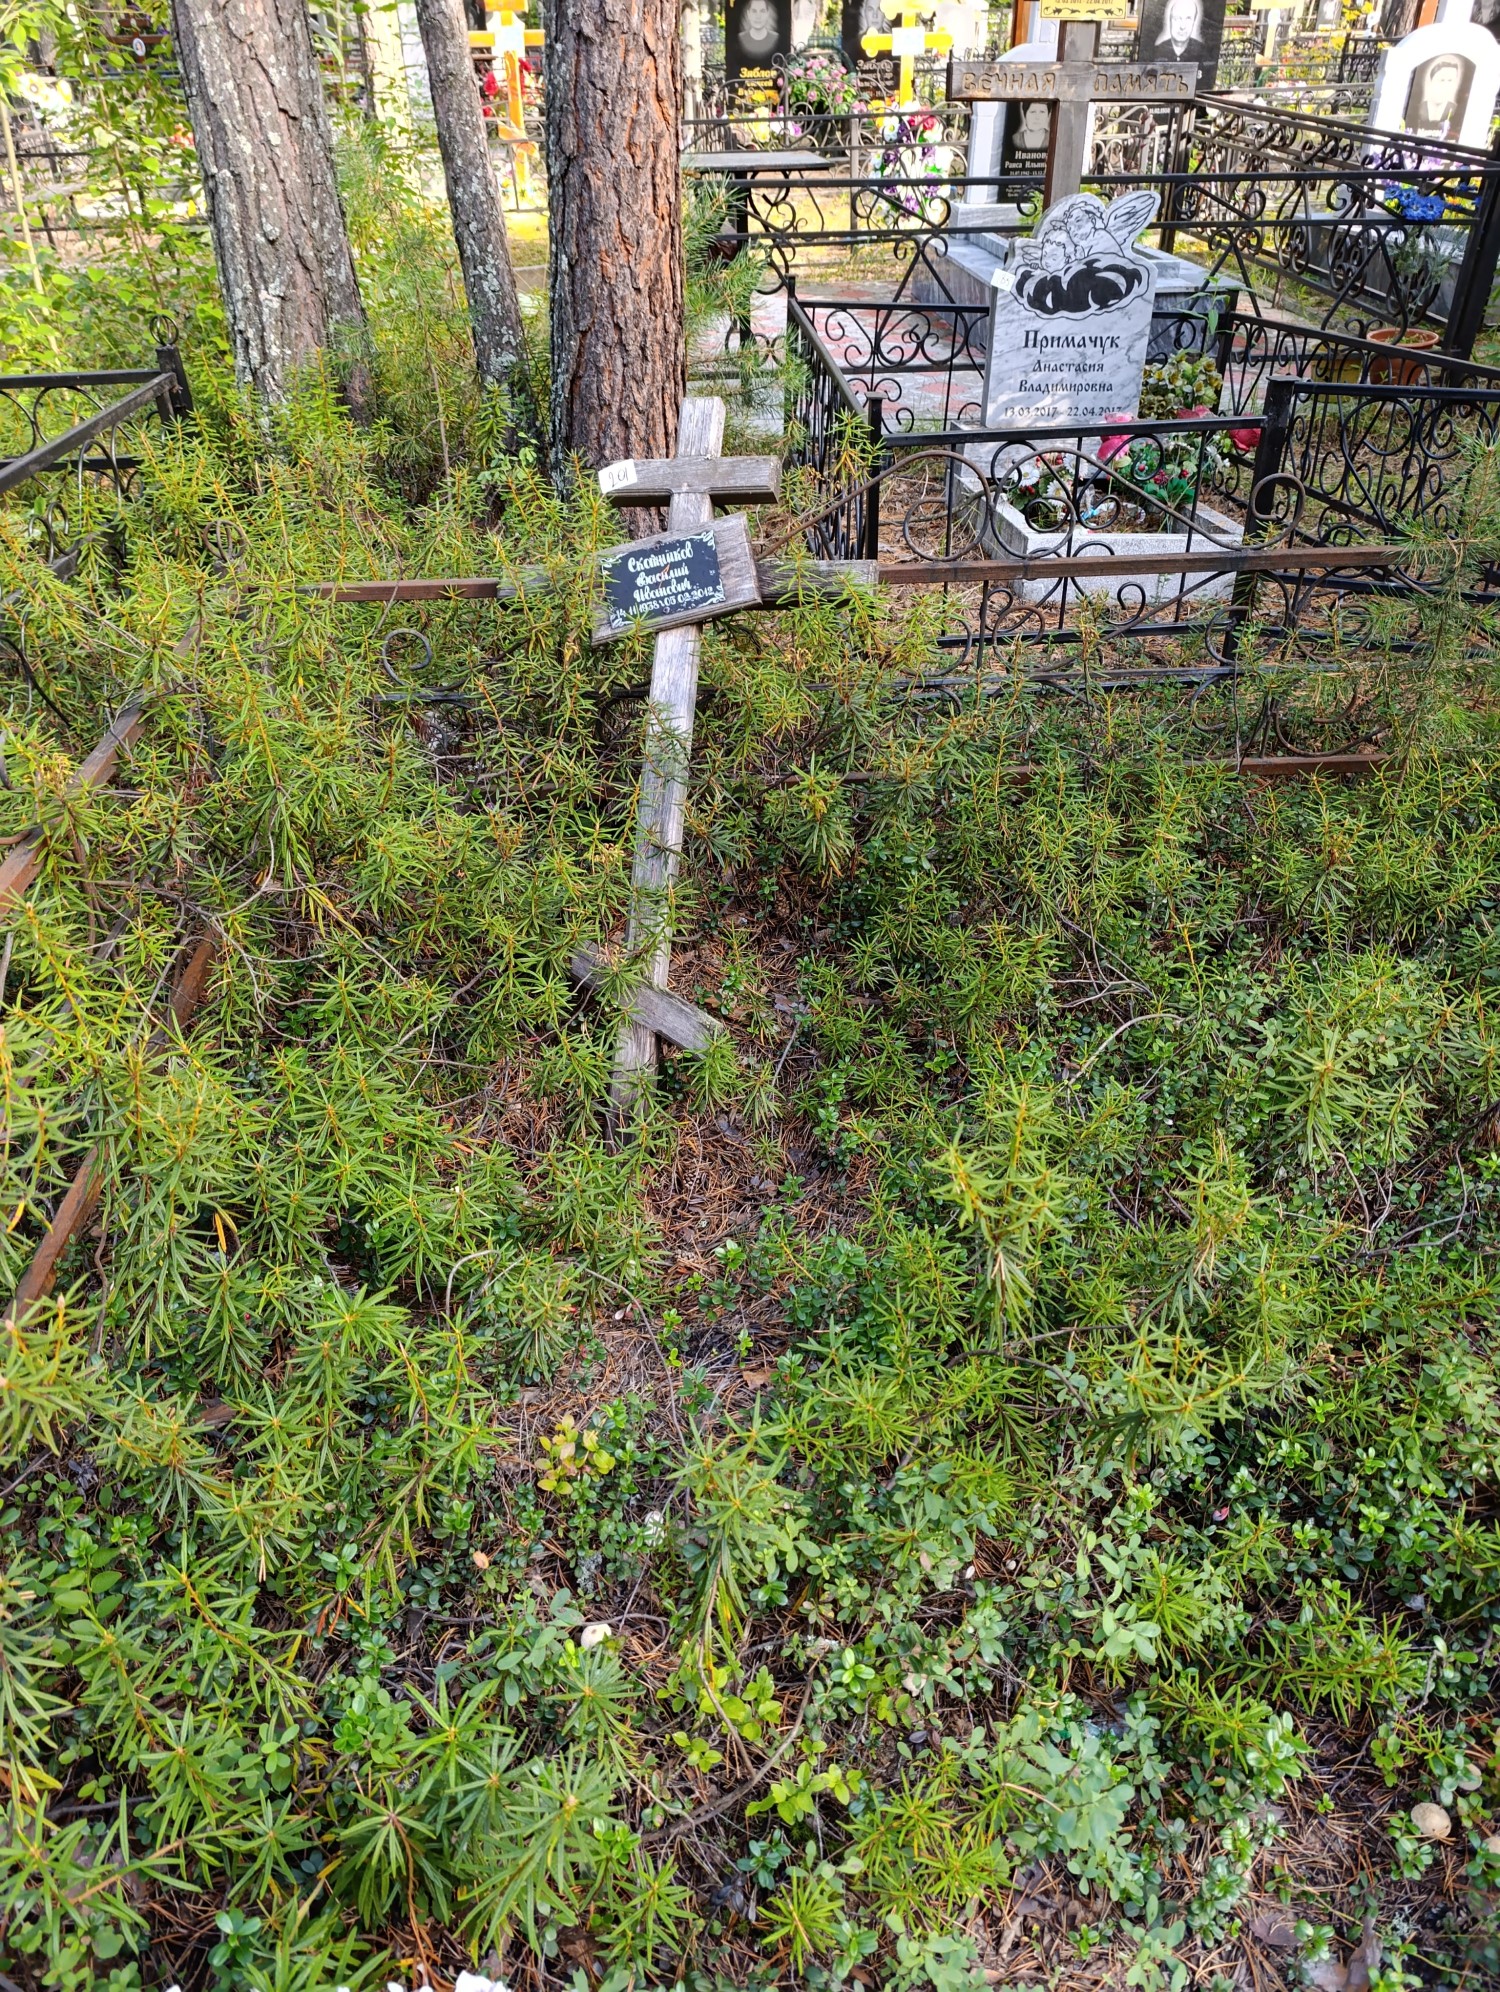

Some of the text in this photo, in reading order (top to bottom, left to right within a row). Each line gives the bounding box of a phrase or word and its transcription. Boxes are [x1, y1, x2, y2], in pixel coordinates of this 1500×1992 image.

[962, 72, 1056, 92] ВЕЧНАЯ
[1094, 73, 1189, 94] ПАМЯТЬ
[1015, 151, 1048, 159] Иванов
[1022, 330, 1121, 354] Примачук
[1032, 360, 1104, 373] Анастасия
[1019, 380, 1113, 395] Владимировна
[1004, 407, 1058, 417] 13.03.2017
[635, 562, 690, 587] Василий
[633, 577, 692, 602] Иванович
